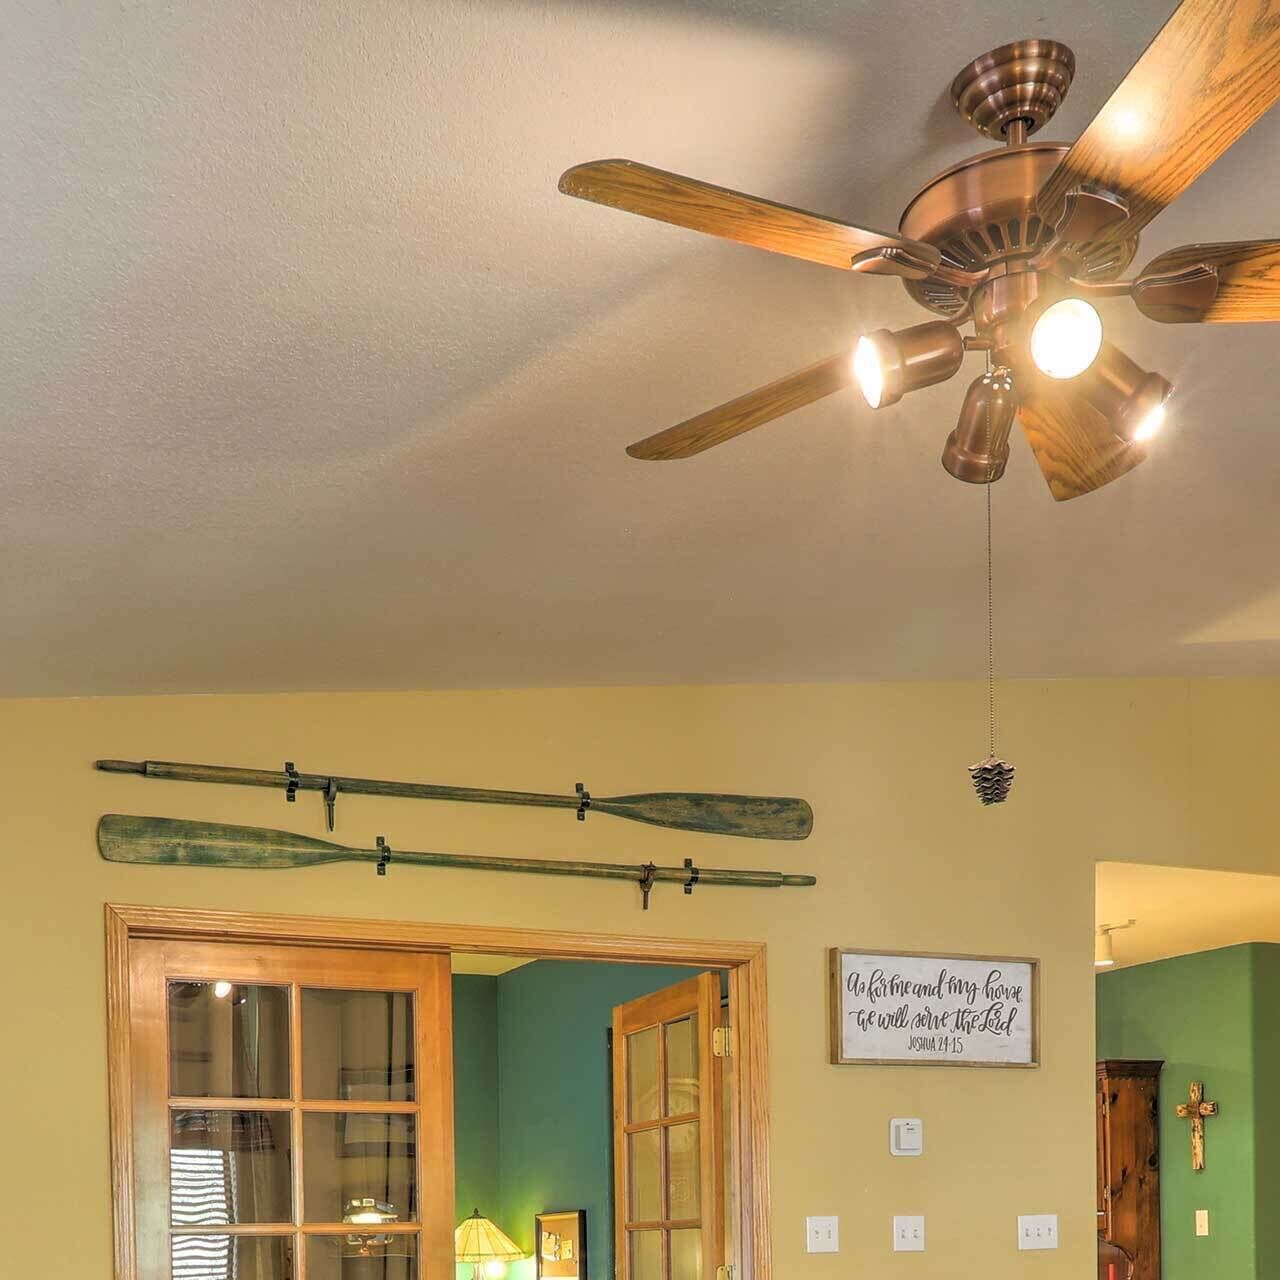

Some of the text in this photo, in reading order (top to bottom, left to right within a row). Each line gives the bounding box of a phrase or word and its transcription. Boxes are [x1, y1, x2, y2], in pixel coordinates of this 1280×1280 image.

[867, 969, 888, 1003] for
[888, 974, 911, 998] me
[912, 968, 947, 1000] and
[946, 975, 979, 1005] my
[849, 1008, 874, 1031] we
[878, 1004, 909, 1029] will
[911, 1006, 951, 1030] serve
[950, 1008, 979, 1035] the
[908, 1035, 936, 1051] JOSHUA
